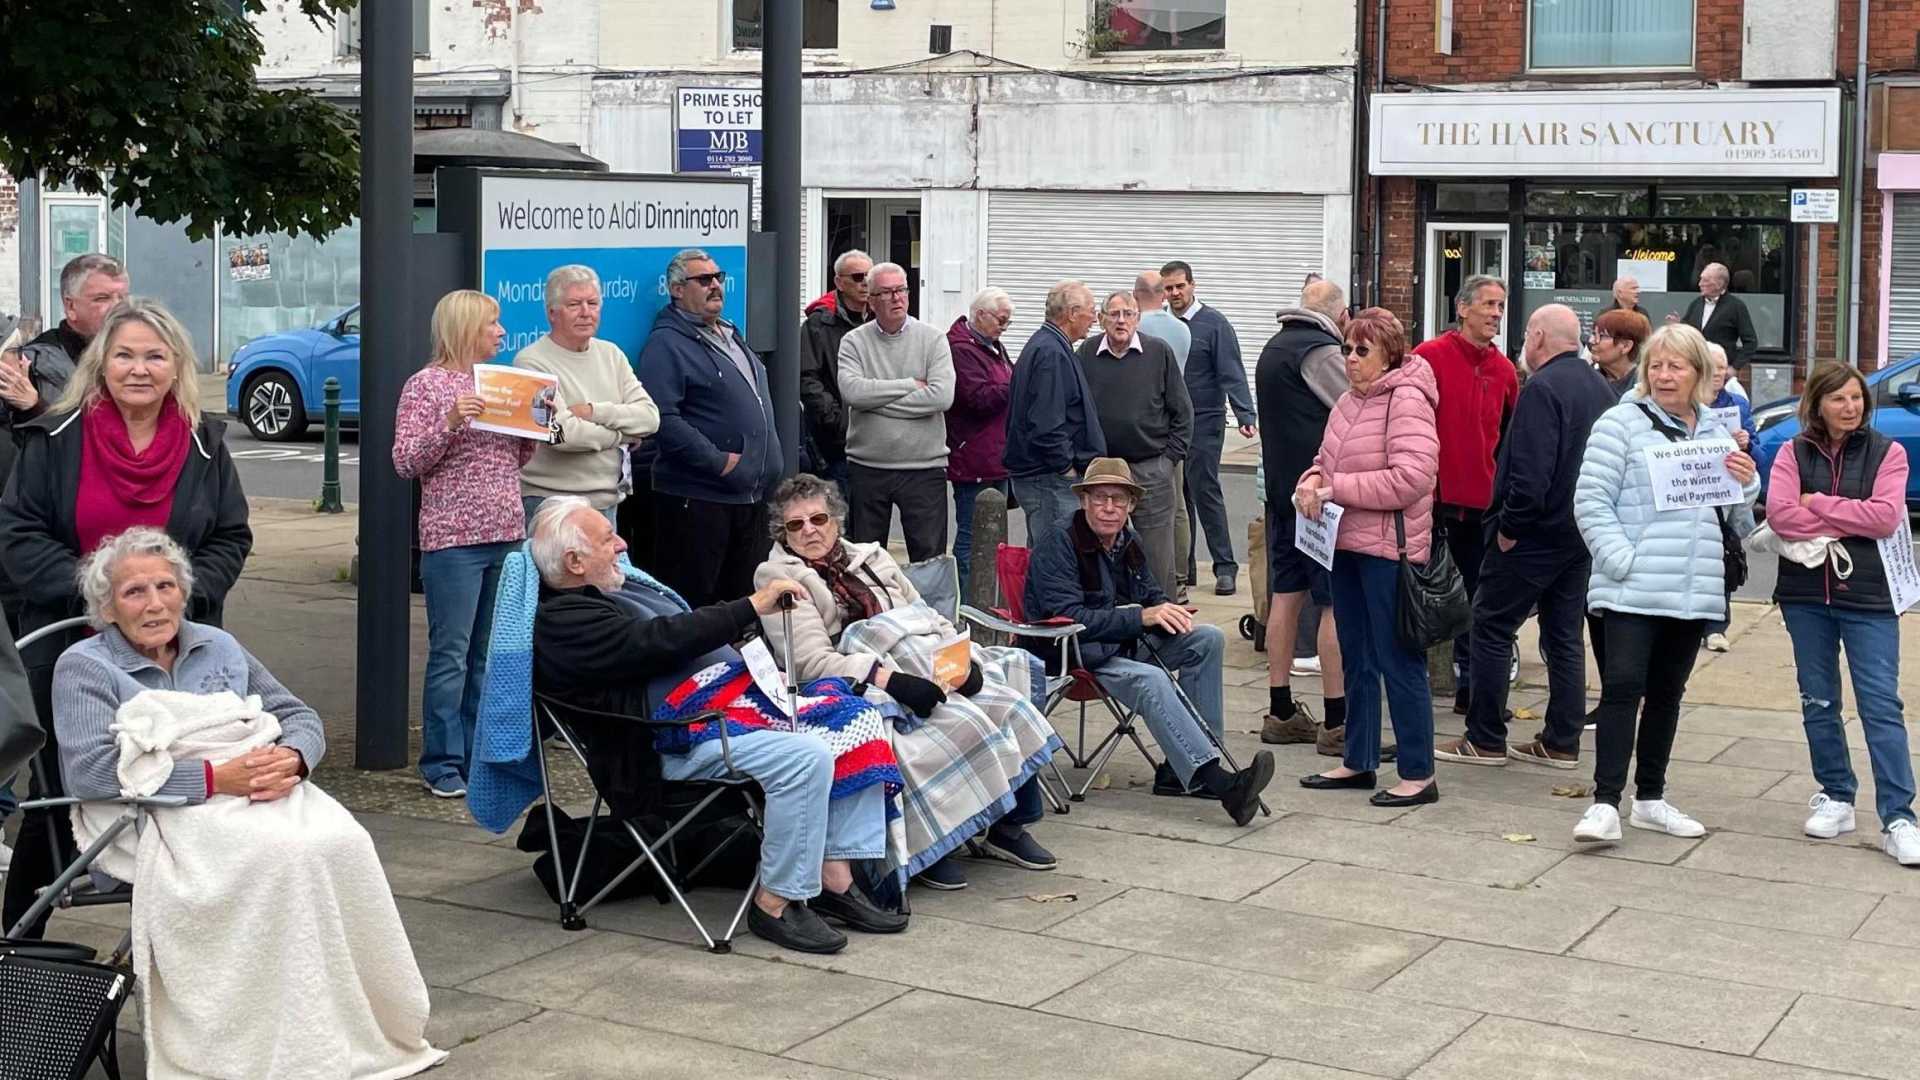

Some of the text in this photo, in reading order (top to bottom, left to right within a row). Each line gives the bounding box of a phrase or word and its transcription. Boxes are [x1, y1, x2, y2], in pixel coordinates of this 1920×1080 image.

[683, 93, 762, 107] PRIME SHO
[704, 111, 753, 125] TO LET
[1417, 120, 1783, 145] THE HAIR SANCTUARY
[709, 131, 748, 153] MJB
[1725, 150, 1765, 159] 01909
[498, 200, 739, 236] Welcome to Aldi Dinnington
[600, 275, 638, 303] urday
[499, 326, 549, 353] Sund
[1654, 445, 1731, 459] We didn't vote
[1681, 461, 1711, 471] to cut
[1672, 476, 1722, 487] the Winter
[1666, 489, 1732, 503] Fuel Payment
